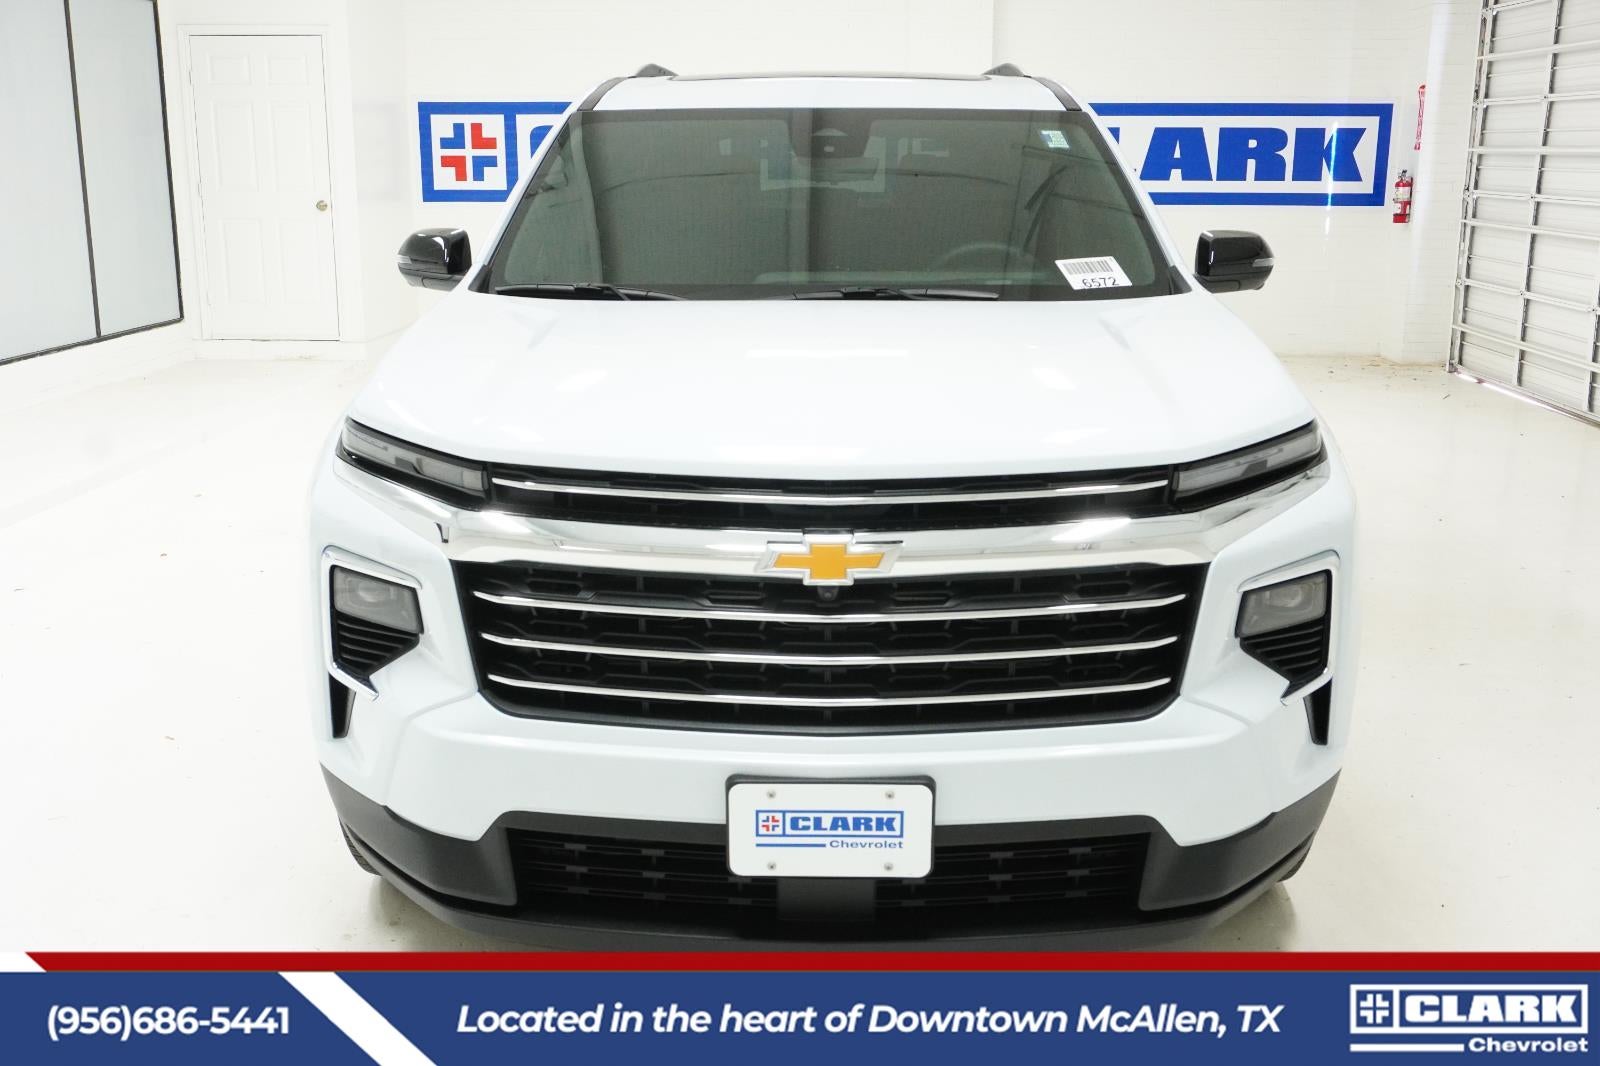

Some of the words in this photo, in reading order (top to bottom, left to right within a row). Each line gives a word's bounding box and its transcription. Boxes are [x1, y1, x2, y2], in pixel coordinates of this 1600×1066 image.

[1108, 127, 1366, 182] ARK
[1081, 276, 1120, 290] 6572
[789, 816, 896, 832] CLARK
[829, 839, 904, 849] Chevrolet
